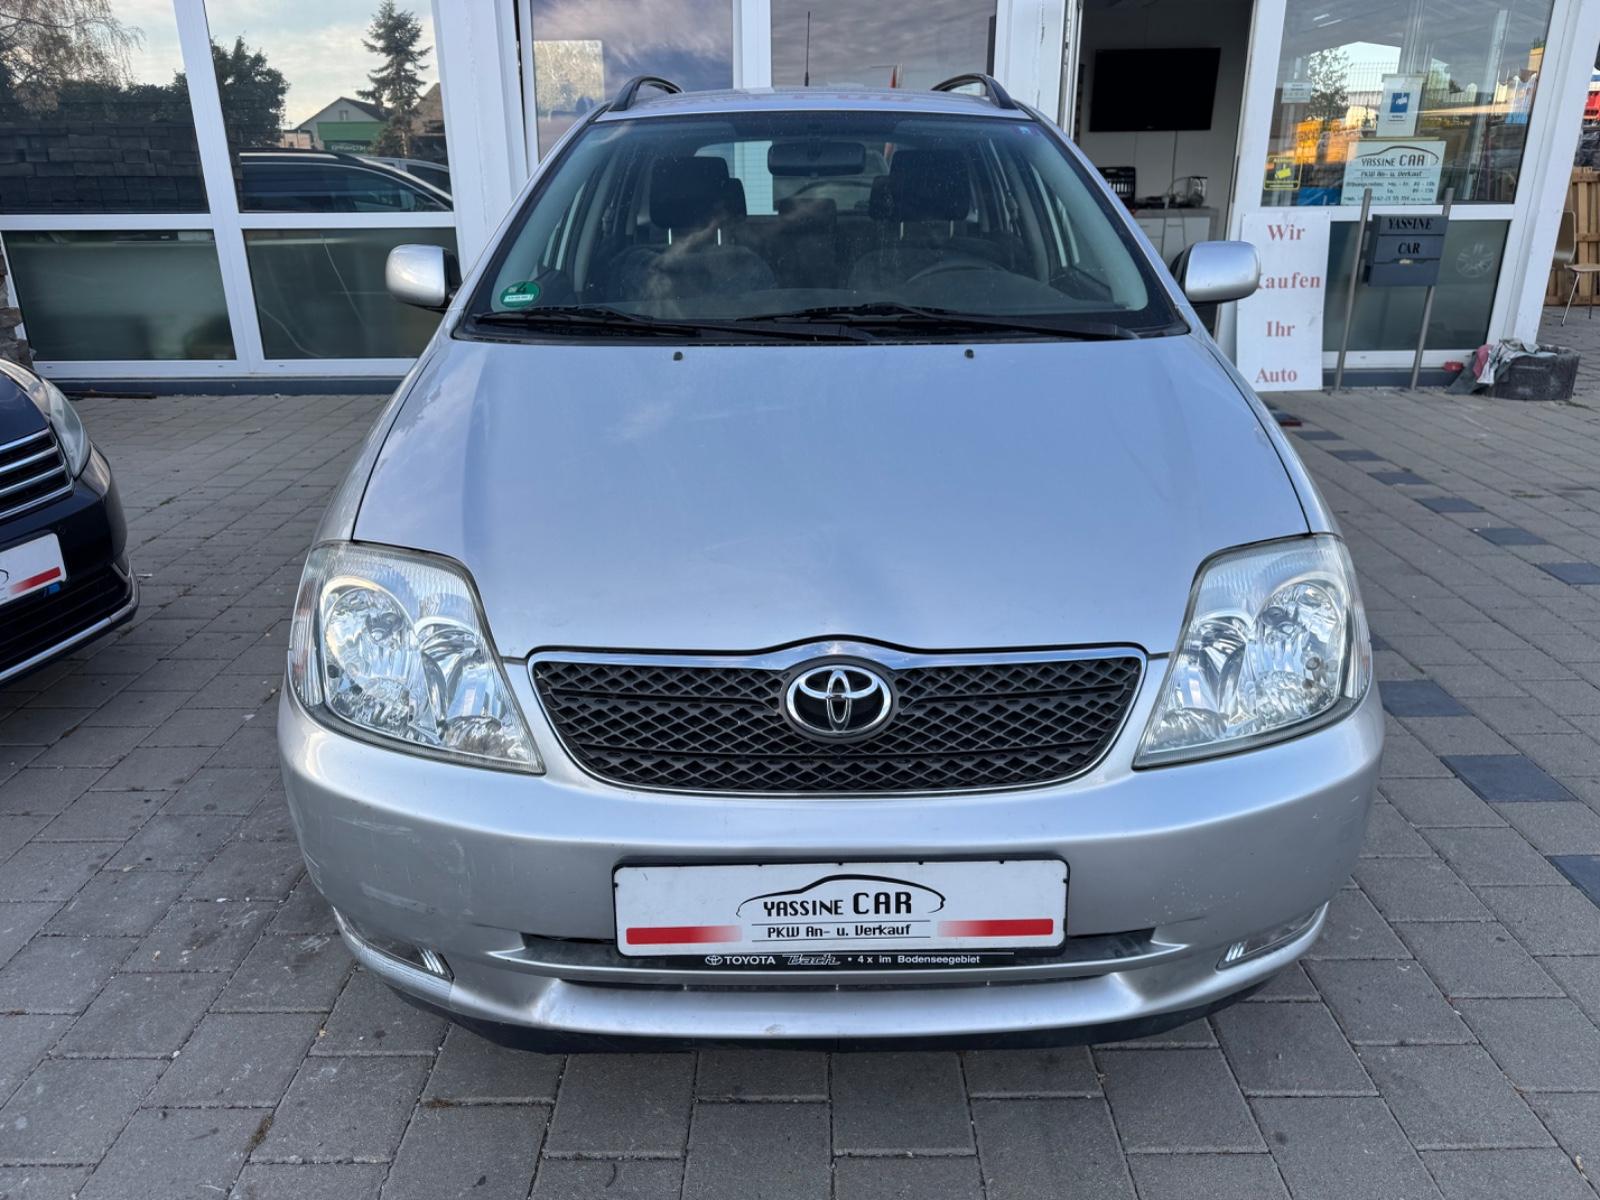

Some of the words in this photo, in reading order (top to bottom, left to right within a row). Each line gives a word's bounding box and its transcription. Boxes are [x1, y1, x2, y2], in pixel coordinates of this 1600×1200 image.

[1361, 157, 1396, 167] YASSINE
[1399, 154, 1425, 167] CAR
[1388, 217, 1434, 230] YASSINE
[1267, 224, 1306, 241] Wir
[1397, 242, 1421, 254] CAR
[1265, 320, 1296, 337] Ihr
[1255, 367, 1298, 384] Auto
[763, 900, 844, 917] YASSINE
[853, 892, 912, 915] CAR
[767, 926, 800, 938] PKW
[806, 926, 831, 937] An-
[836, 926, 849, 937] u.
[854, 924, 912, 937] Verkauf
[724, 955, 776, 965] TOYOTA
[878, 955, 892, 964] im
[897, 955, 981, 966] Bodenseegebiet
